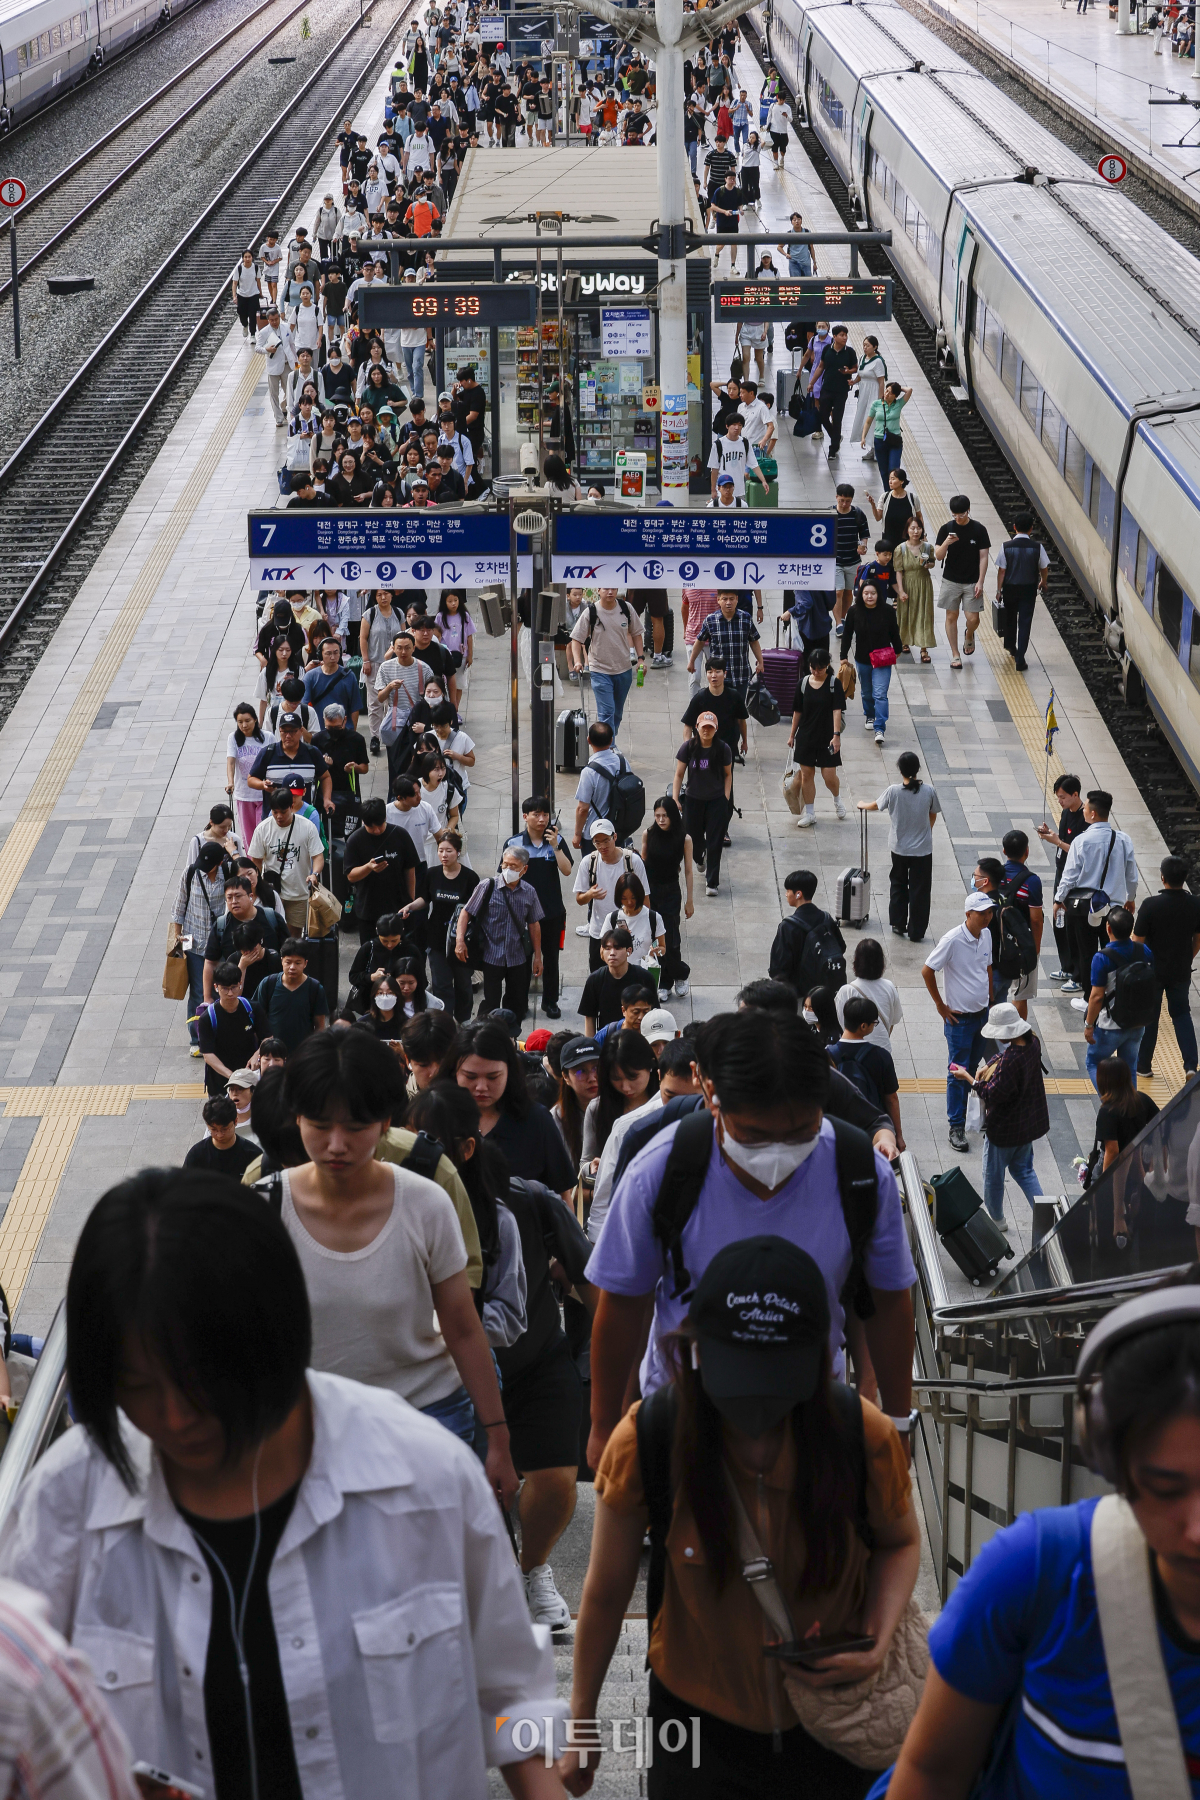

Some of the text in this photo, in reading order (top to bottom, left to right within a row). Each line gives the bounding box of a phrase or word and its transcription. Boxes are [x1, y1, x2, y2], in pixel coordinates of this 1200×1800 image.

[1109, 159, 1116, 169] 8
[1109, 169, 1116, 179] 6
[8, 183, 15, 193] 8
[8, 193, 15, 202] 6
[412, 296, 480, 317] 09:39
[725, 451, 744, 463] HUF
[317, 520, 461, 530] 대전 동대구 부산 포항 진주 마산 강릉
[623, 519, 637, 528] 대전
[643, 519, 664, 528] 동대구
[671, 519, 685, 528] 부산
[712, 519, 727, 528] 진주
[733, 520, 747, 528] 마산
[753, 520, 768, 529] 강릉
[260, 524, 277, 548] 7
[317, 535, 443, 545] 익산 광주송정 목포 여수EXPO 방면
[641, 534, 656, 543] 익산
[661, 534, 690, 543] 광주송정
[696, 534, 710, 543] 목포
[810, 523, 828, 548] 8
[261, 565, 304, 581] KTX
[341, 564, 361, 578] 18
[381, 564, 392, 579] 9
[562, 564, 606, 579] KTX
[644, 563, 663, 577] 18
[684, 564, 694, 578] 9
[777, 563, 823, 576] 호차번호
[726, 1292, 800, 1314] Couch Potato
[739, 1307, 784, 1322] Atelier
